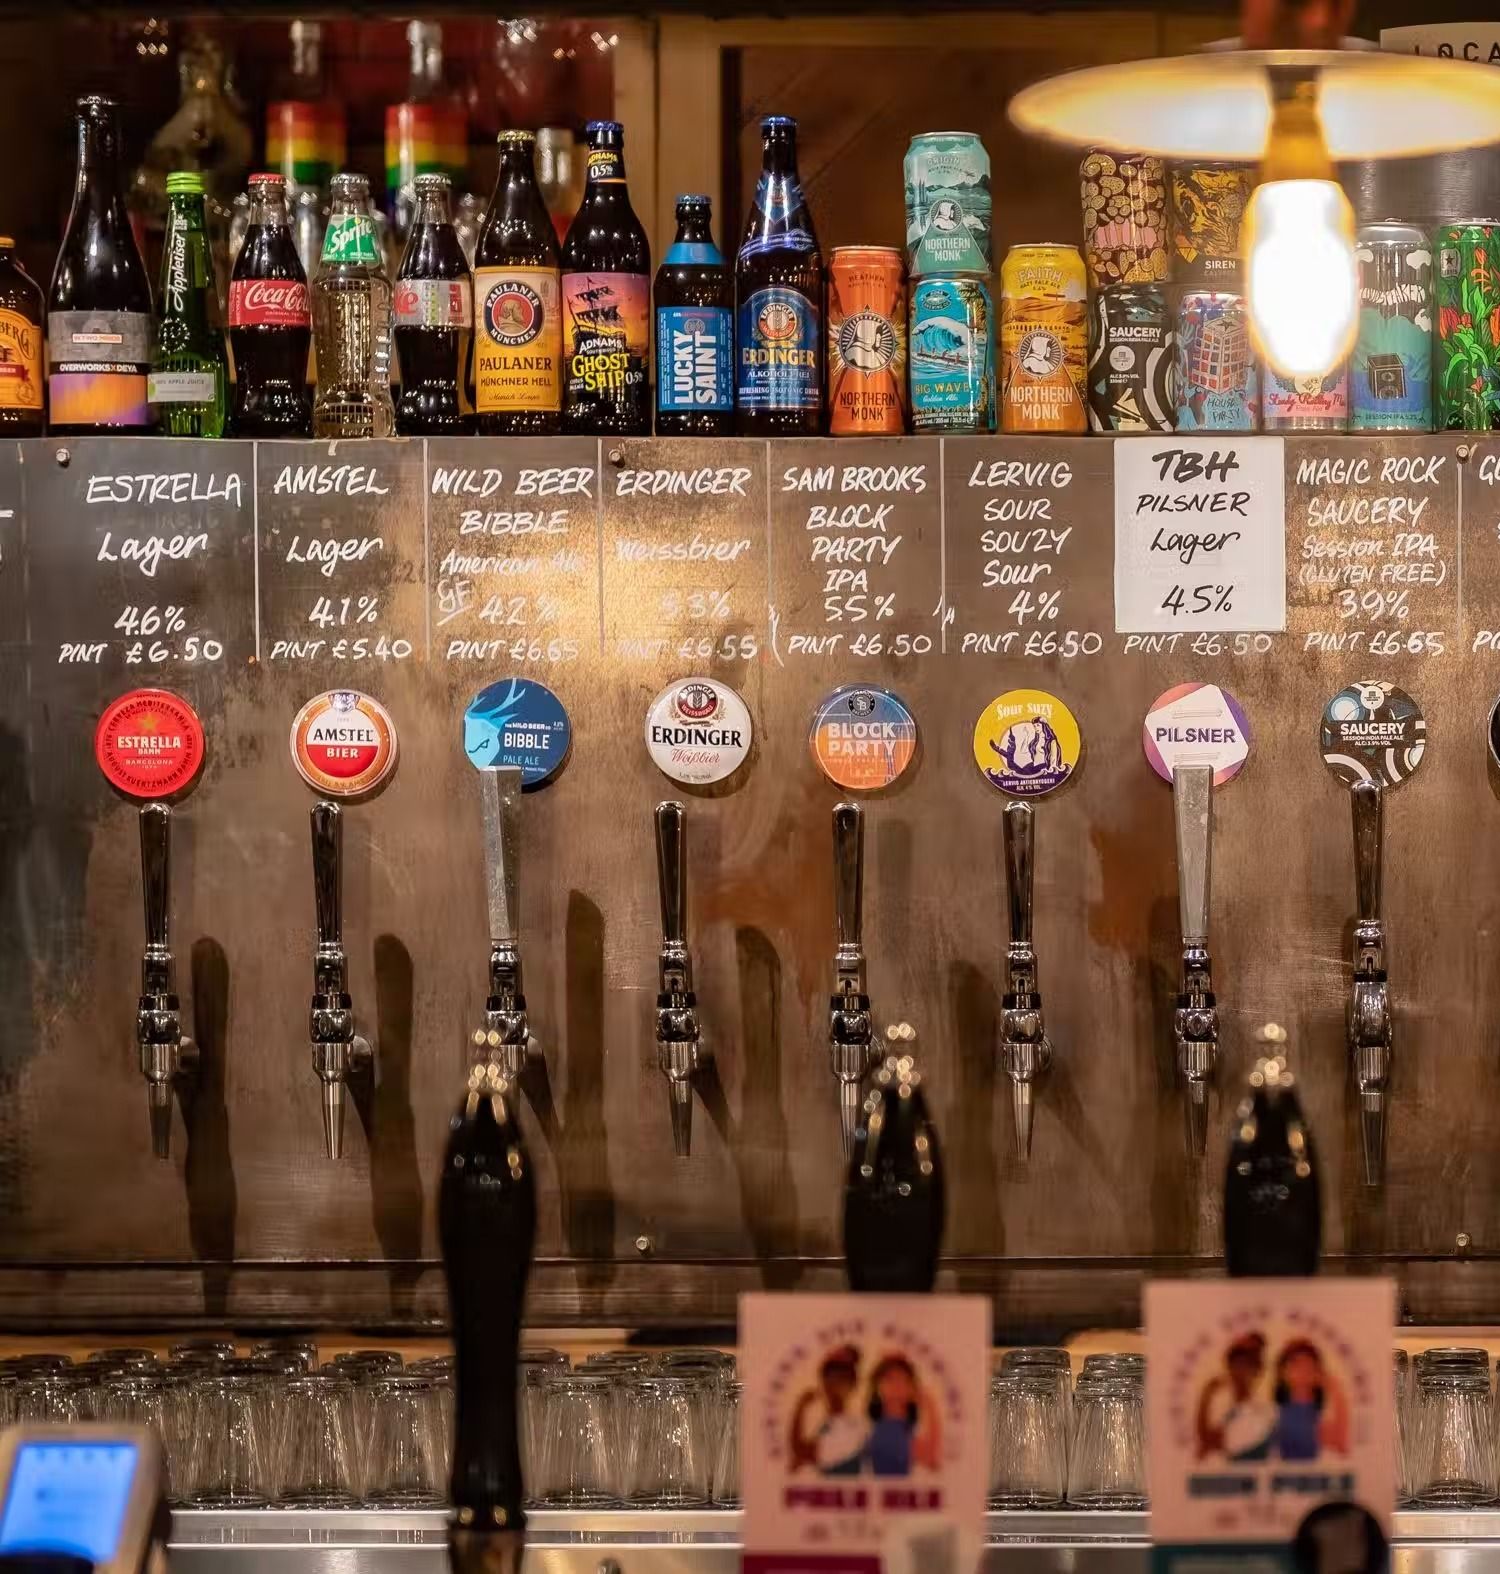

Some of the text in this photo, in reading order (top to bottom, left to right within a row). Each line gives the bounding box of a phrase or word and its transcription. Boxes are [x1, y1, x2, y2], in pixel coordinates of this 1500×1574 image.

[925, 238, 971, 250] NORTHERN
[934, 250, 961, 261] MONK
[1205, 260, 1236, 269] SIREN
[486, 281, 540, 309] PAULANER
[1109, 327, 1162, 339] SAUCERY
[480, 357, 552, 371] PAULANER
[571, 352, 631, 378] GHOST
[673, 330, 694, 405] LUCKY
[695, 331, 717, 405] SAINT
[742, 347, 815, 368] ERDINGER
[584, 371, 625, 392] SHIP
[1010, 386, 1073, 402] NORTHERN
[839, 391, 895, 406] NORTHERN
[851, 406, 884, 421] MONK
[1022, 405, 1060, 420] MONK
[782, 465, 927, 494] SAM BROOKS
[968, 461, 1072, 488] LERVIG
[1152, 450, 1240, 483] TBH
[1296, 456, 1447, 486] MAGIC ROCK
[86, 472, 241, 507] ESTRELLA
[273, 465, 389, 495] AMSTEL
[432, 467, 595, 498] WILD BEER
[616, 467, 752, 497] ERDINGER
[984, 498, 1052, 522] SOUR
[1136, 492, 1250, 516] PILSNER
[1308, 496, 1429, 527] SAUCERY
[460, 509, 569, 535] BIBBLE
[806, 504, 894, 532] BLOCK
[97, 532, 208, 577] Lager
[286, 534, 383, 577] Lager
[811, 535, 902, 565] PARTY
[1150, 528, 1241, 564] Lager
[1301, 533, 1439, 559] Session IPA
[440, 549, 538, 575] American
[982, 559, 1051, 587] Sour
[1380, 560, 1447, 587] FREE)
[823, 569, 868, 593] IPA
[309, 596, 378, 628] 4.1%
[824, 593, 896, 622] 5.5%
[1008, 590, 1062, 625] 4%
[1161, 585, 1234, 616] 4.5%
[114, 605, 186, 636] 4.6%
[58, 637, 223, 664] PINT £6.50
[270, 638, 412, 660] PINT £5.40
[849, 634, 932, 657] £6.50
[1024, 631, 1102, 657] £6.50
[1124, 633, 1272, 656] PINT £6.50
[313, 728, 374, 742] AMSTEL
[504, 732, 550, 750] BIBBLE
[652, 725, 743, 748] ERDINGER
[827, 722, 896, 739] BLOCK
[1155, 725, 1236, 745] PILSNER
[1340, 722, 1406, 735] SAUCERY
[117, 735, 181, 749] ESTRELLA
[326, 747, 358, 758] BIER
[828, 740, 897, 757] PARTY
